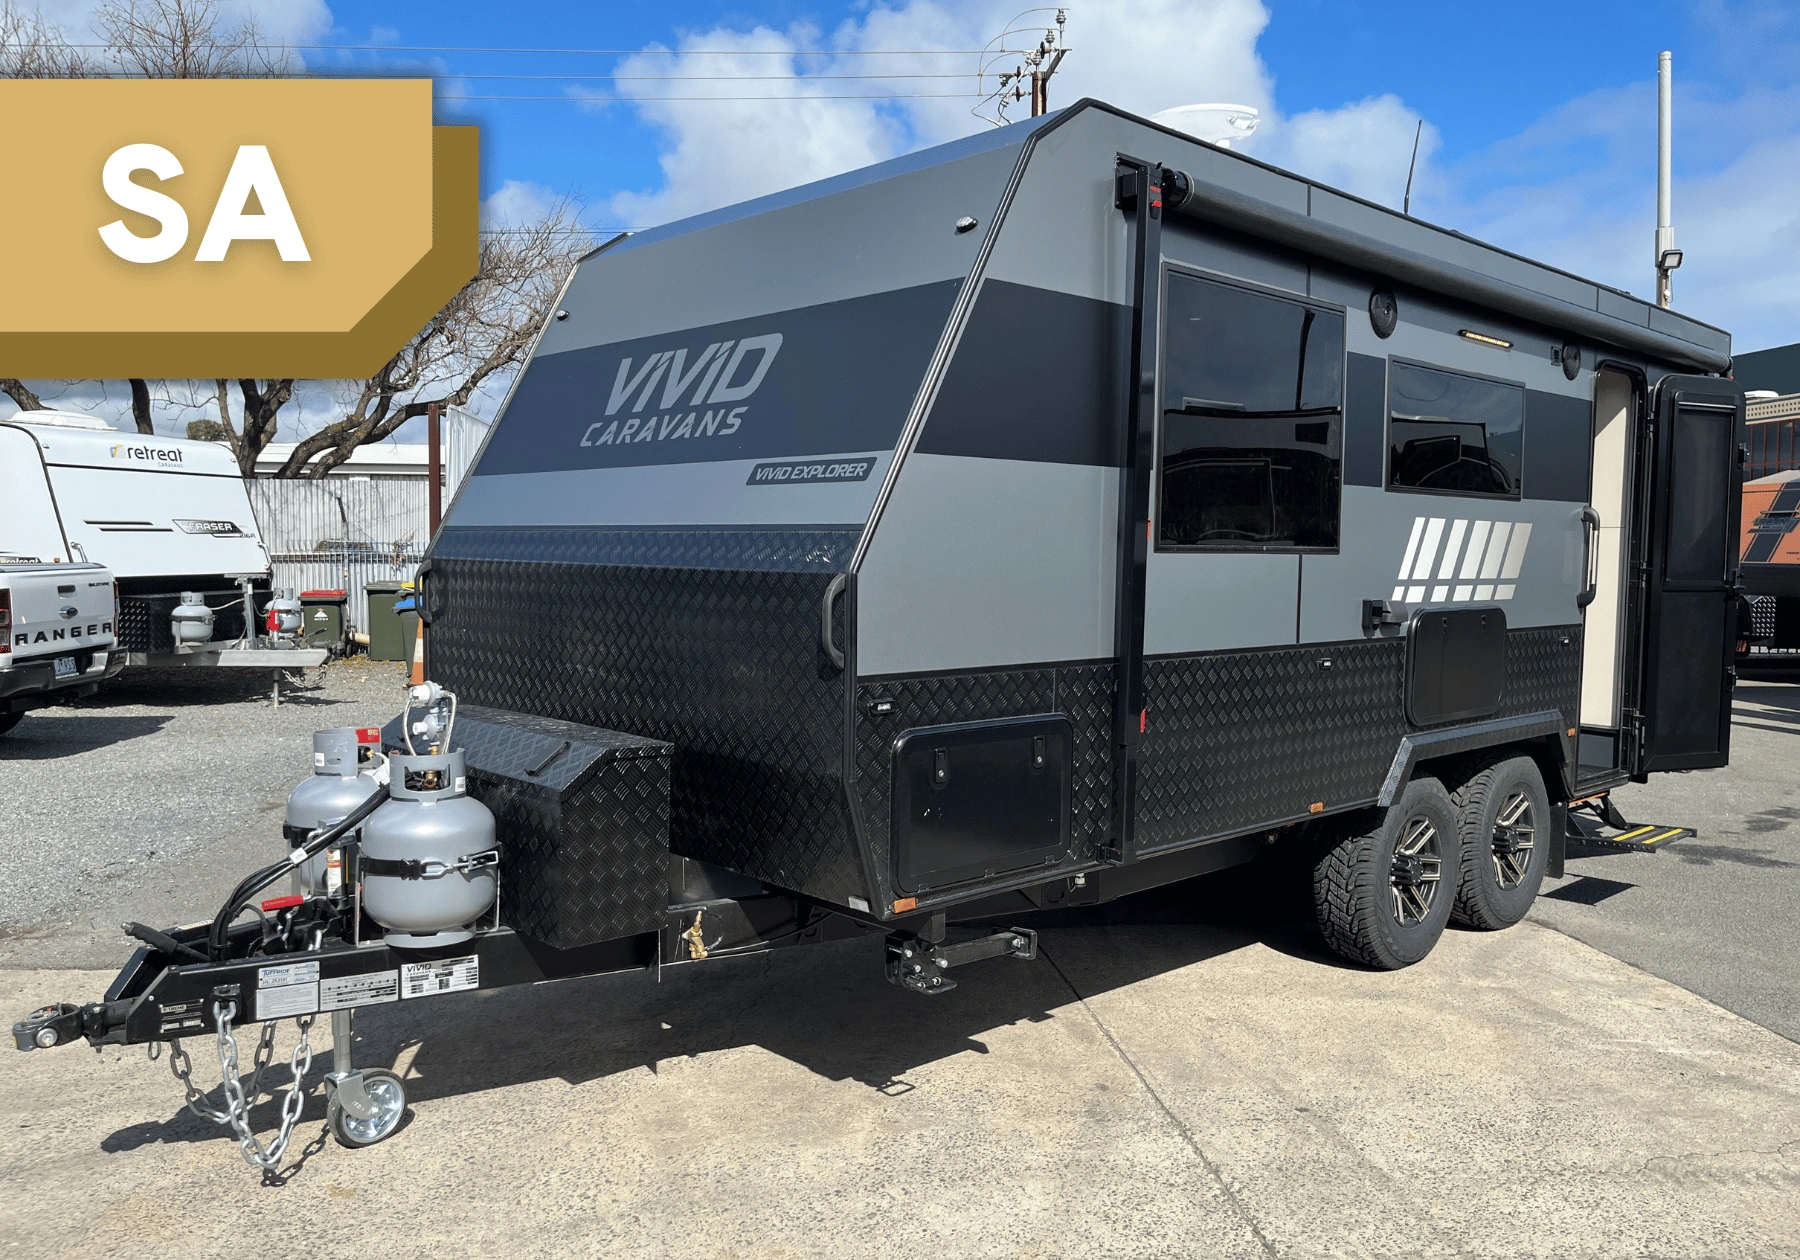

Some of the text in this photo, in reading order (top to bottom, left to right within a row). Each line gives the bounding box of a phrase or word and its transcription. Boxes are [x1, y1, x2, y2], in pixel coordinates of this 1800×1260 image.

[604, 332, 783, 416] VIVID
[580, 406, 749, 447] CARAVANS
[127, 445, 183, 462] retreat
[157, 461, 184, 469] CARAVANS
[755, 462, 868, 481] VIVID EXPLORER
[189, 522, 233, 531] FRASER
[14, 622, 112, 646] RANGER
[406, 963, 432, 973] VIVID
